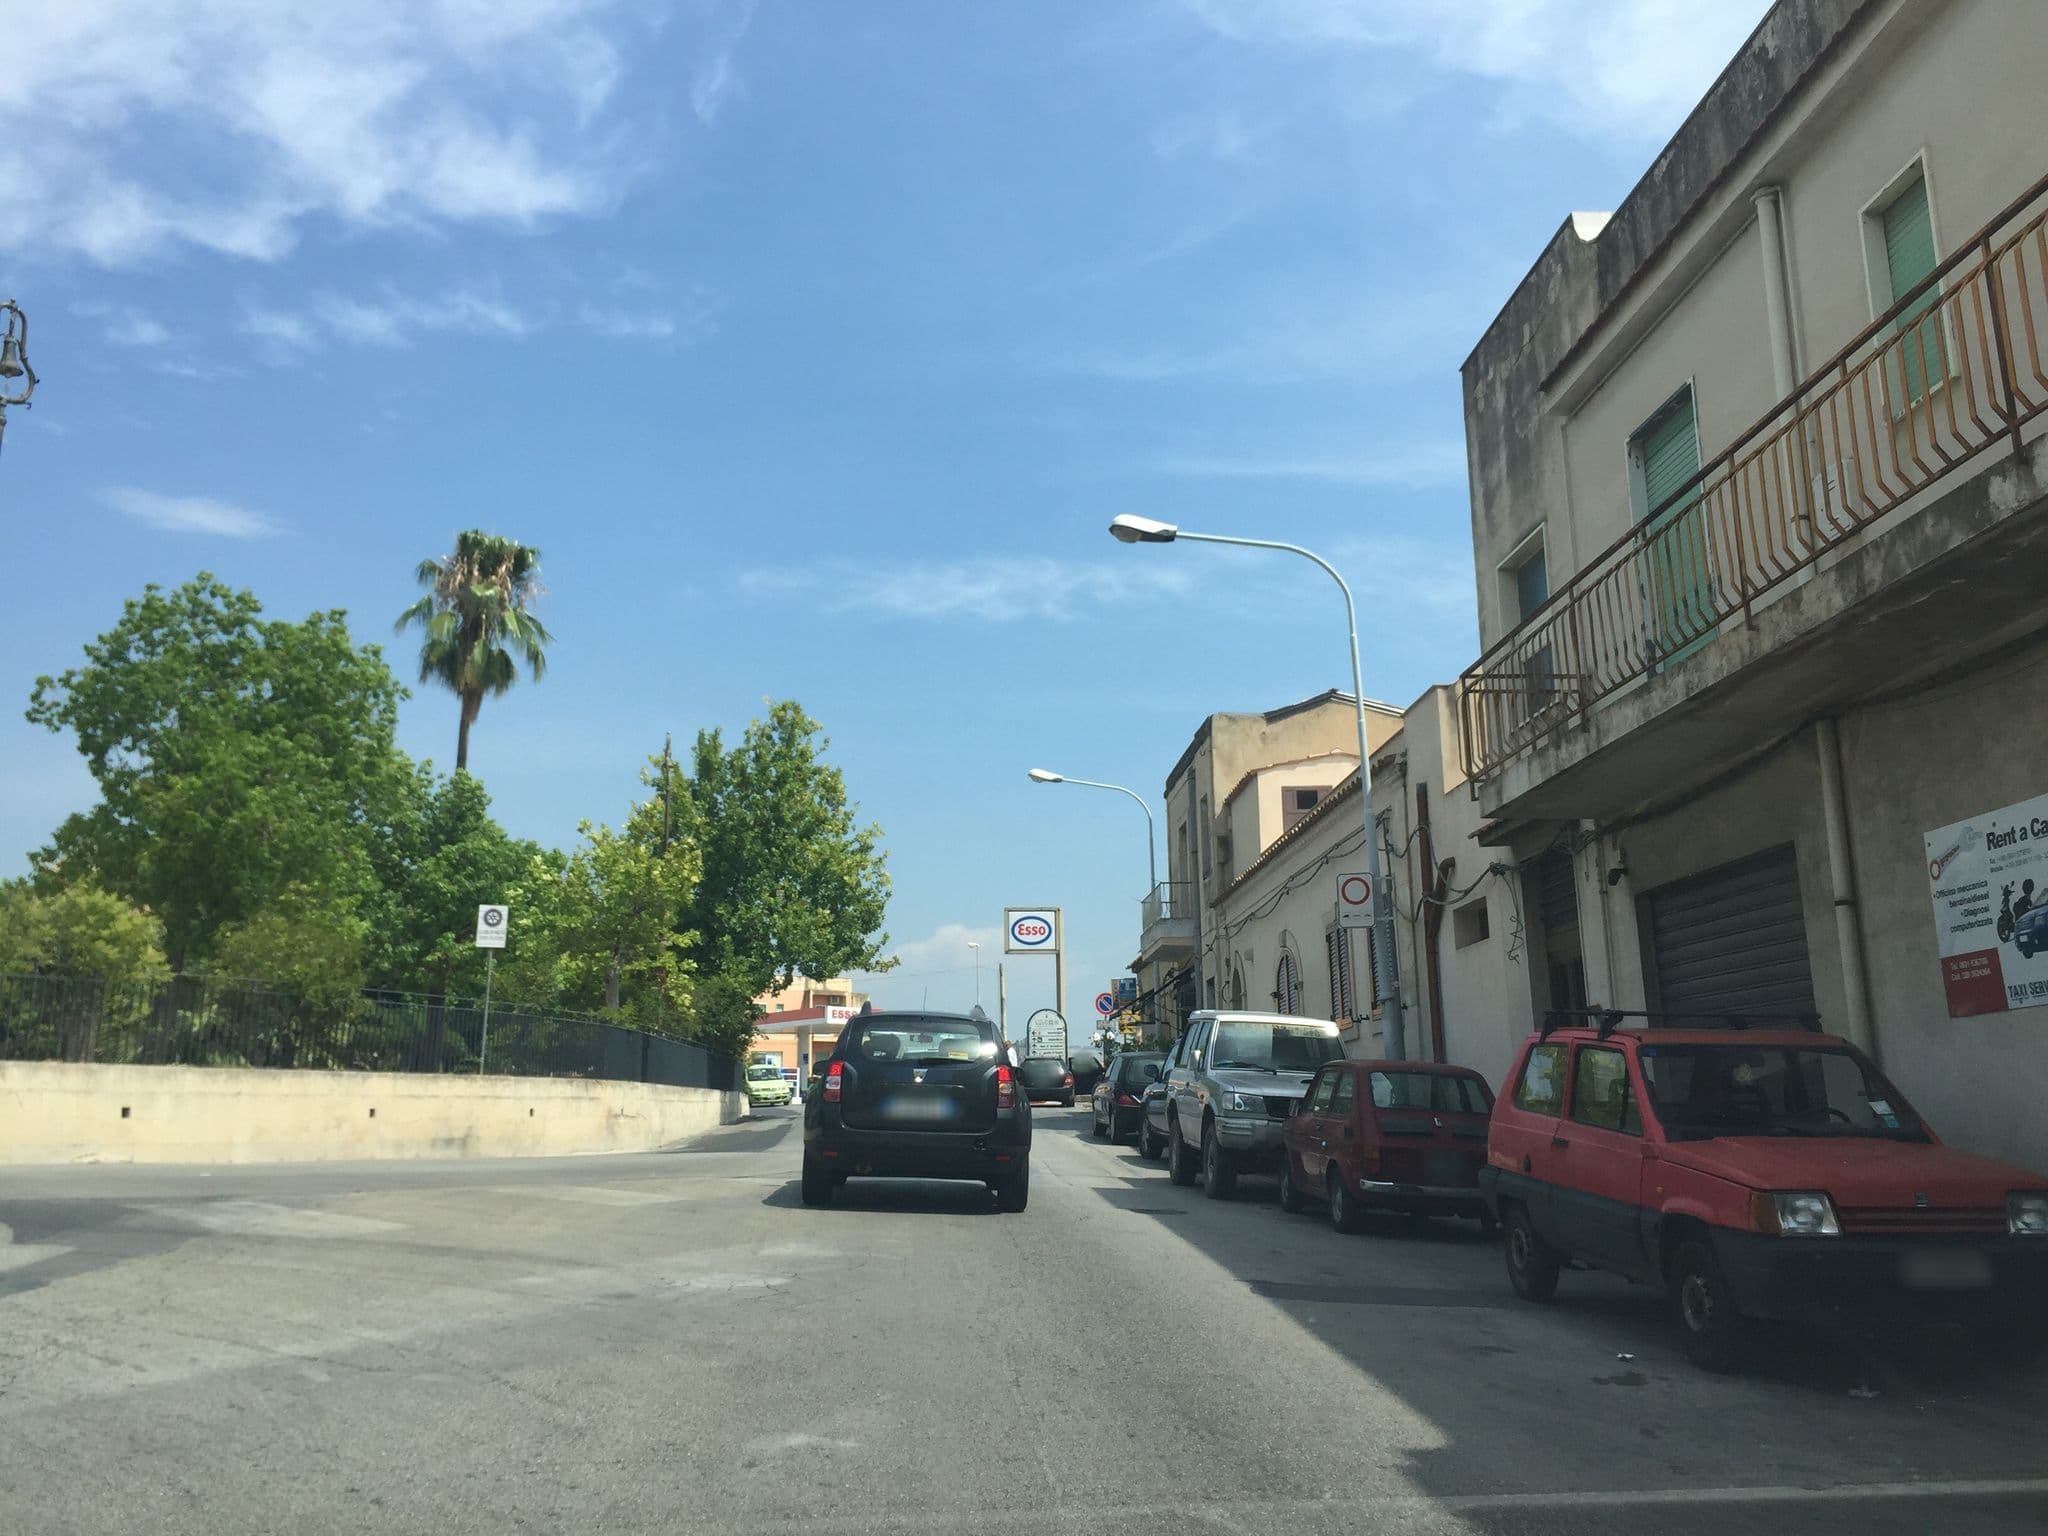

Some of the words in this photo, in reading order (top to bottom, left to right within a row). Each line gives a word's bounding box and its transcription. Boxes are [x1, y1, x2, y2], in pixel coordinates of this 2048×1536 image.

[1986, 825, 2017, 851] Rent
[2019, 826, 2028, 841] a
[1018, 923, 1046, 936] Esso
[2007, 983, 2028, 998] TAXI
